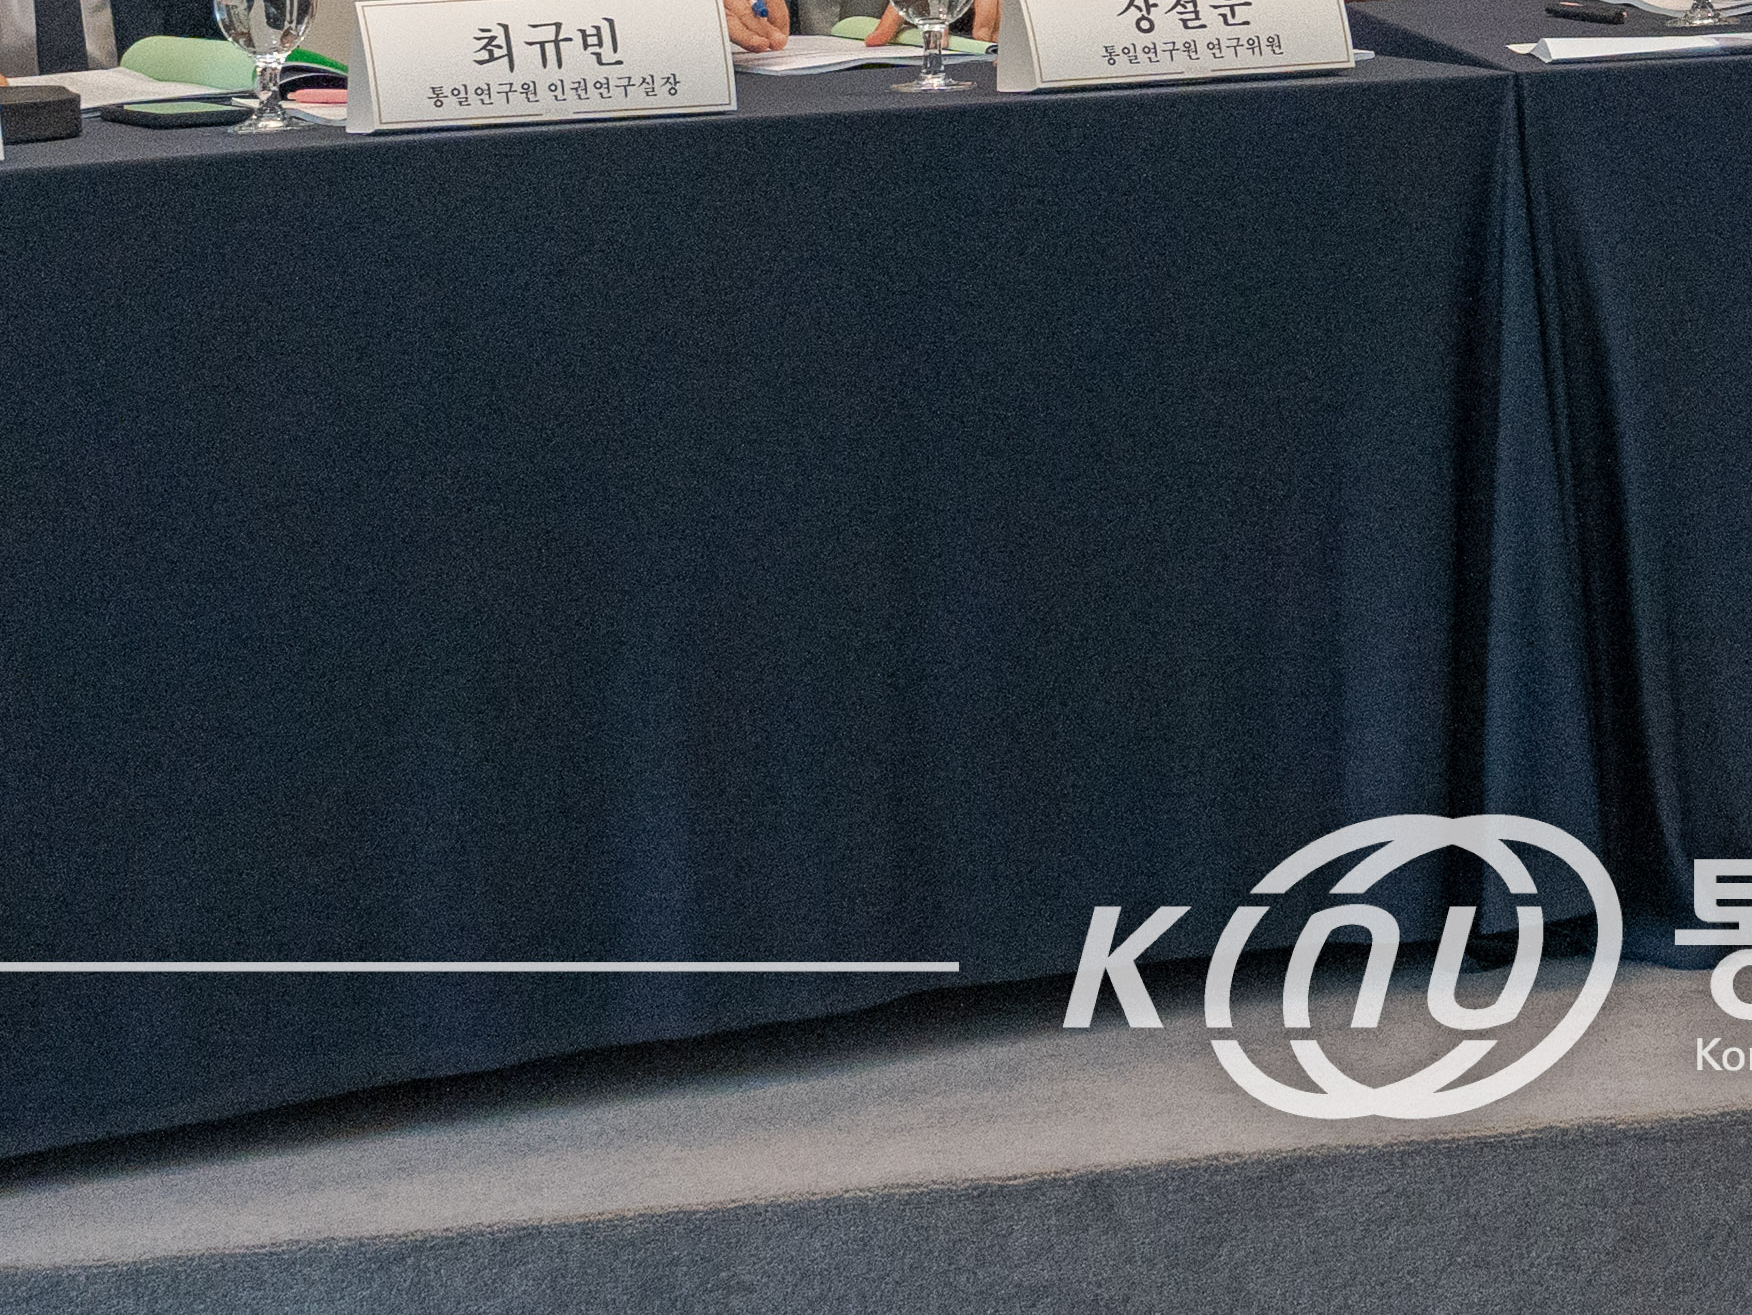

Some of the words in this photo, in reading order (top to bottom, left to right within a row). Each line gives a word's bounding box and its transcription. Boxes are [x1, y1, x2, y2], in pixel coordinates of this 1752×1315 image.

[473, 16, 625, 75] 최규빈
[1101, 38, 1201, 67] 통일연구원
[1205, 33, 1284, 60] 연구위원
[427, 80, 540, 109] 통일연구원
[547, 72, 681, 103] 인권연구실장
